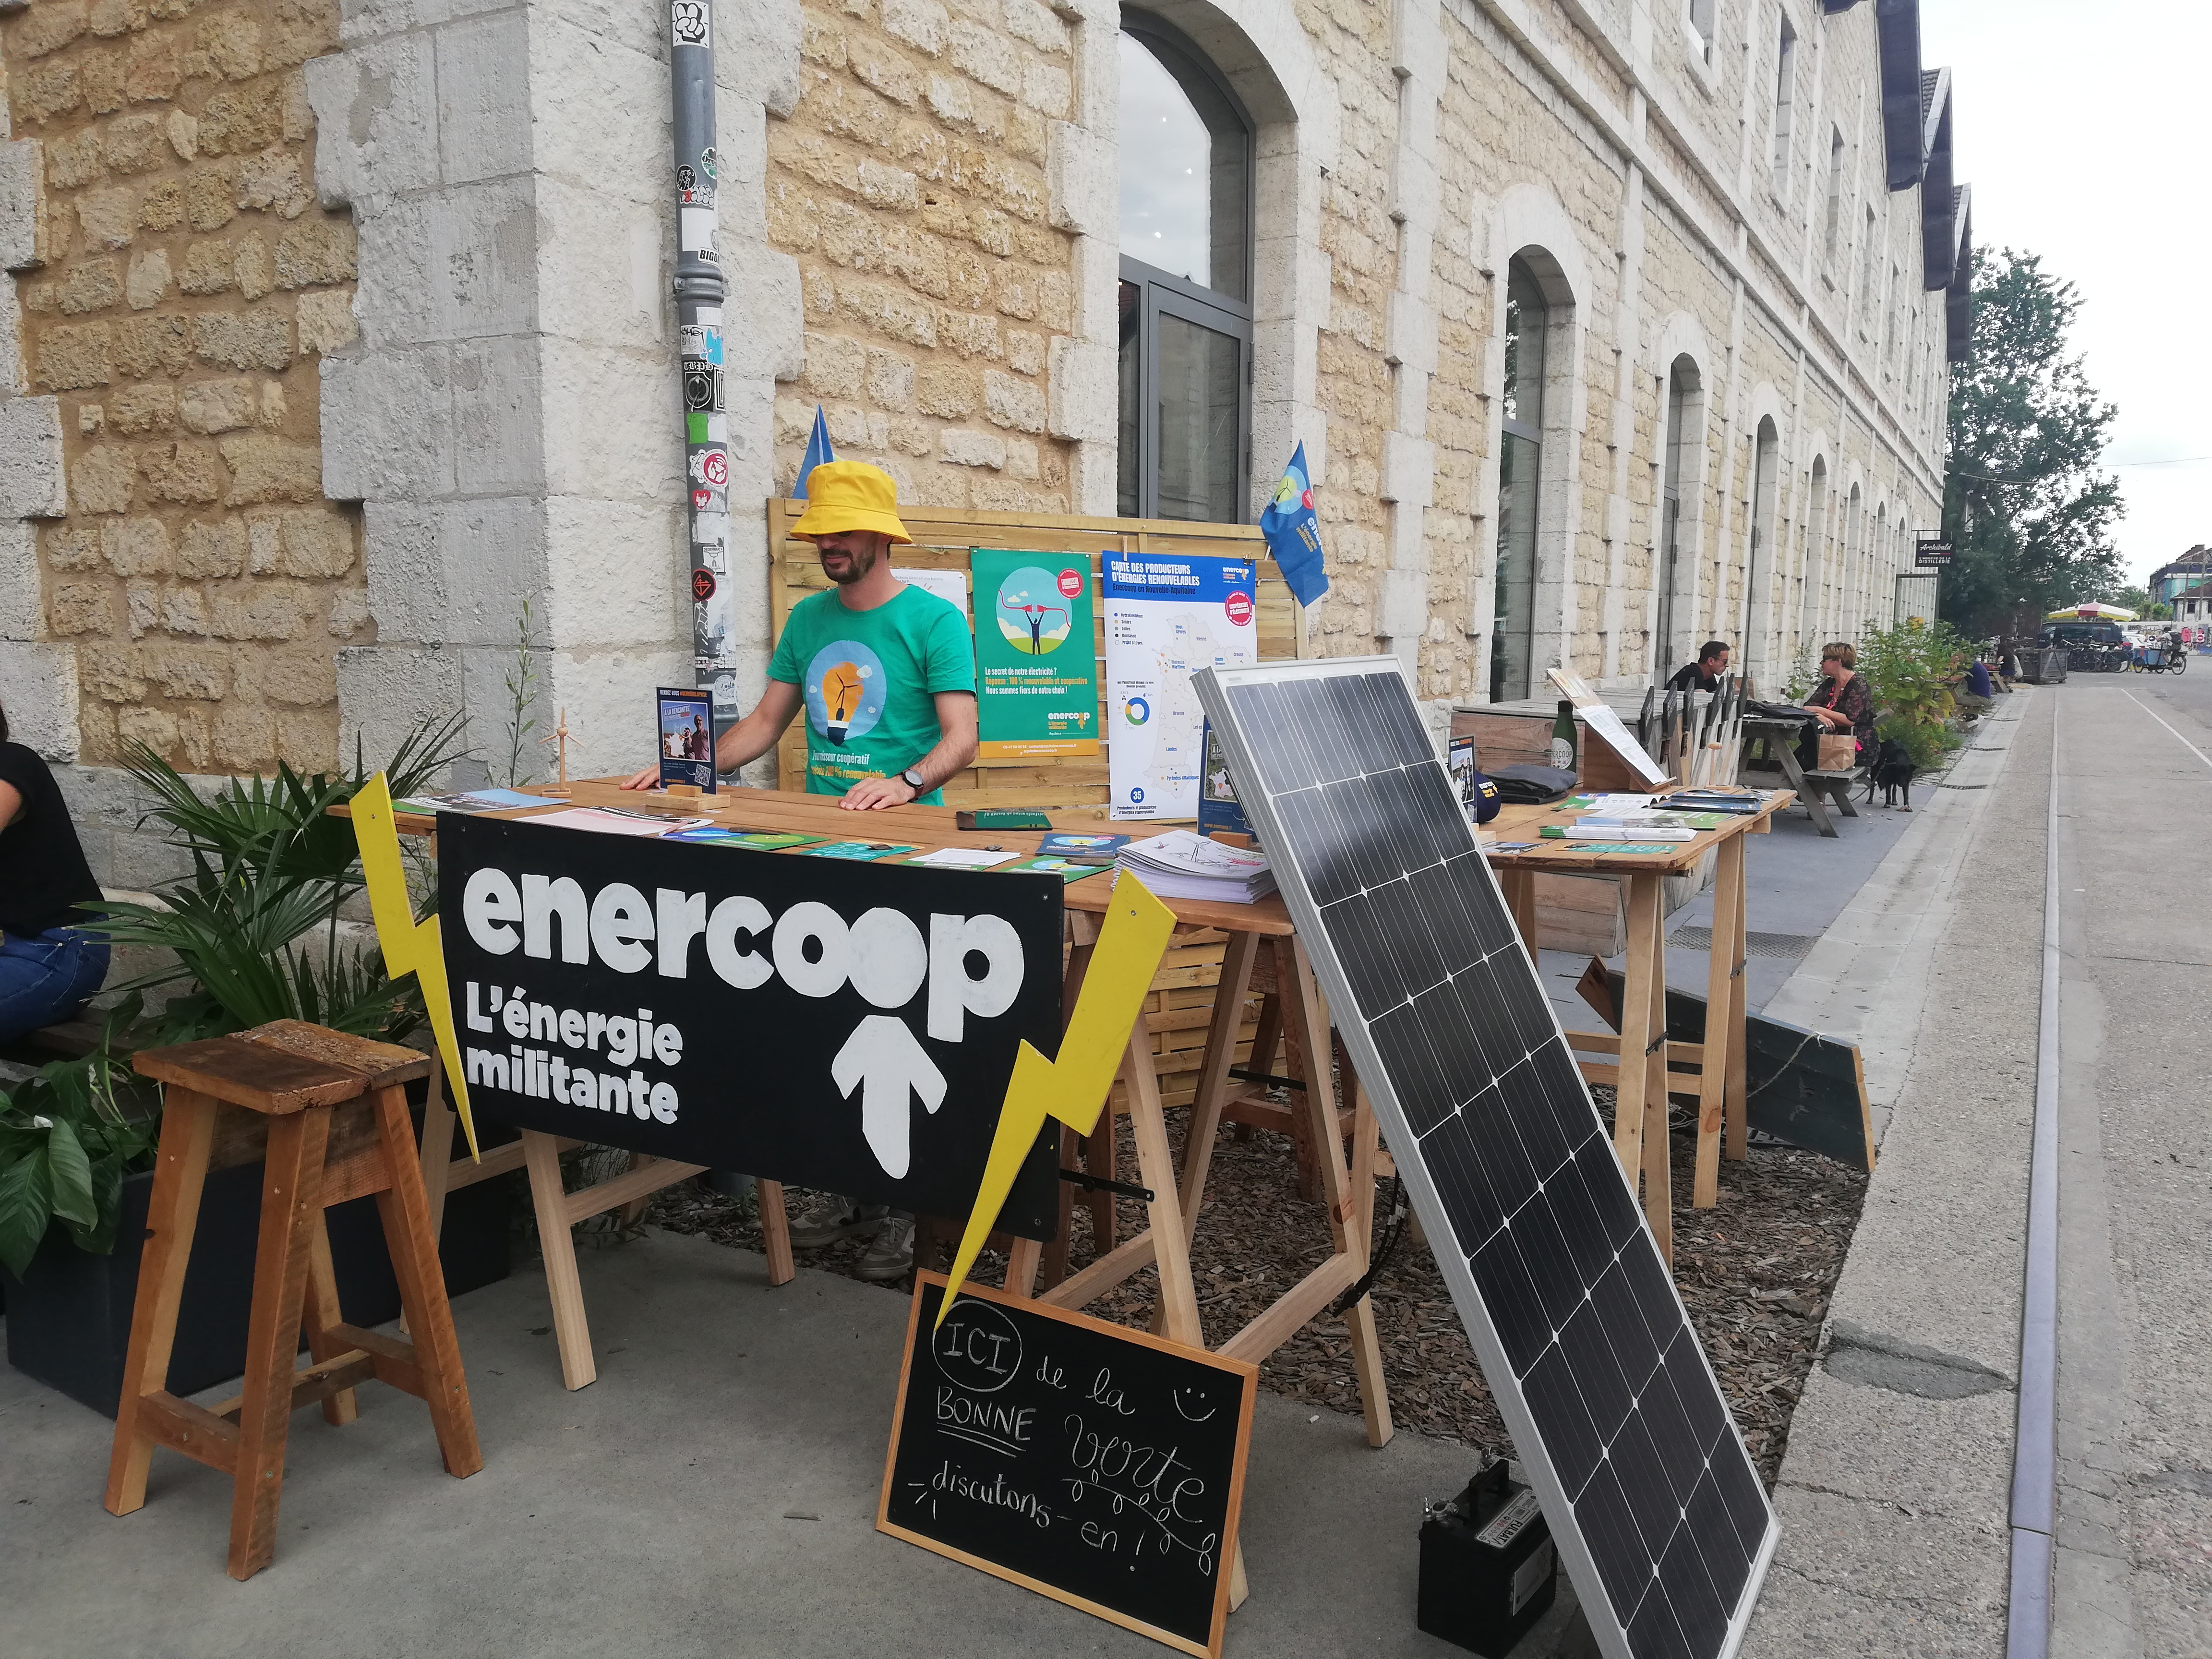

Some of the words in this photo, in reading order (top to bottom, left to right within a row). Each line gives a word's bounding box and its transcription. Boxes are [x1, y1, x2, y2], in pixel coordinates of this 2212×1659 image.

[1111, 561, 1130, 572] CARTE
[1131, 563, 1143, 573] DES
[1145, 563, 1190, 575] PRODUCTEURS
[1112, 571, 1146, 584] D'ÉNERGIES
[1148, 574, 1200, 586] RENOUVELABLES
[1113, 583, 1137, 593] Enercoop
[1146, 586, 1196, 595] Nouvelle-Aquitaine
[985, 667, 991, 675] Le
[1029, 667, 1053, 675] électricité
[1054, 667, 1057, 675] ?
[1018, 677, 1023, 685] %
[986, 686, 998, 694] Nous
[1019, 686, 1031, 694] fiers
[1052, 686, 1064, 694] choix
[1065, 686, 1068, 694] !
[837, 753, 870, 766] coopératif
[1551, 750, 1572, 759] ERCOOP
[1133, 791, 1142, 800] 35
[463, 867, 1024, 1042] enercoop
[466, 981, 682, 1066] L'énergie
[467, 1045, 679, 1124] militante
[942, 1323, 1010, 1374] ICI
[1036, 1356, 1067, 1389] de
[1085, 1368, 1135, 1415] la
[937, 1386, 1036, 1442] BONNE
[1499, 1520, 1524, 1543] FULBAT
